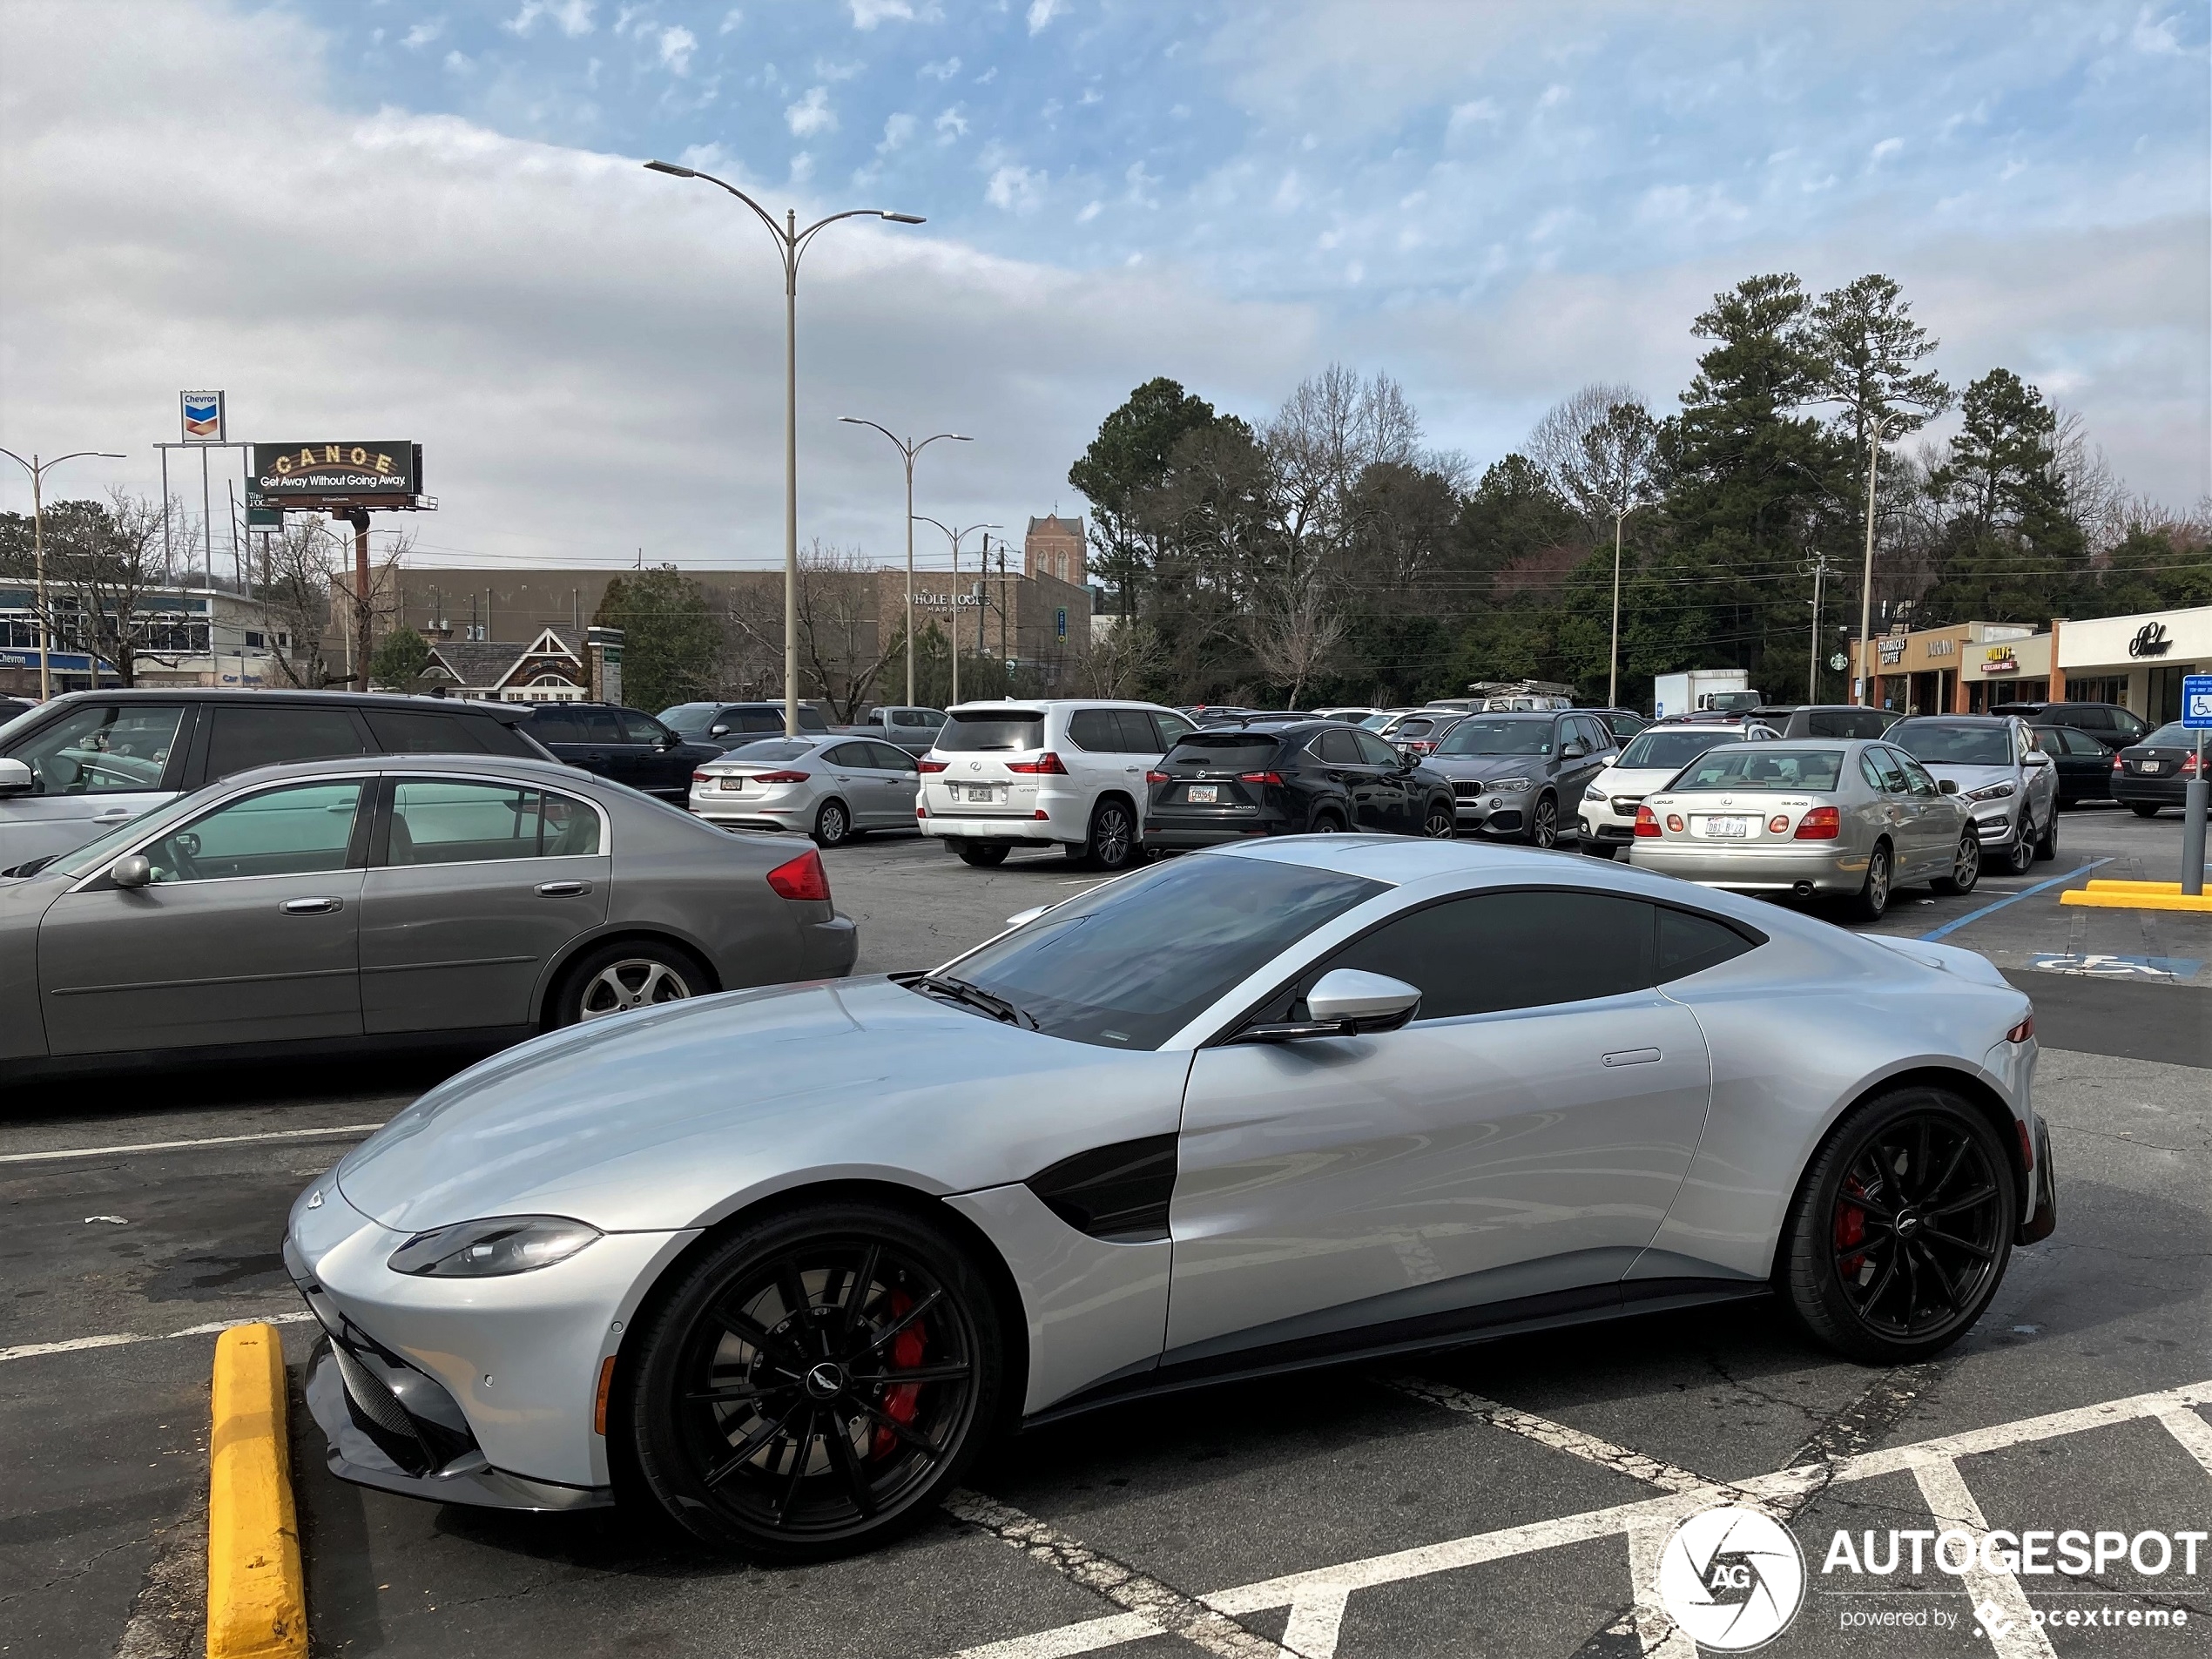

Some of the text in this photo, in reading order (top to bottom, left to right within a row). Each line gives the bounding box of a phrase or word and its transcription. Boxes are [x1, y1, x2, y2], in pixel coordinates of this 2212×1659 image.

[185, 395, 217, 403] Chevron
[275, 445, 392, 475] CANOE
[260, 475, 406, 489] Get Away Without Going Away.
[1878, 638, 1905, 652] STARBUCKS
[1881, 651, 1900, 664] COFFEE
